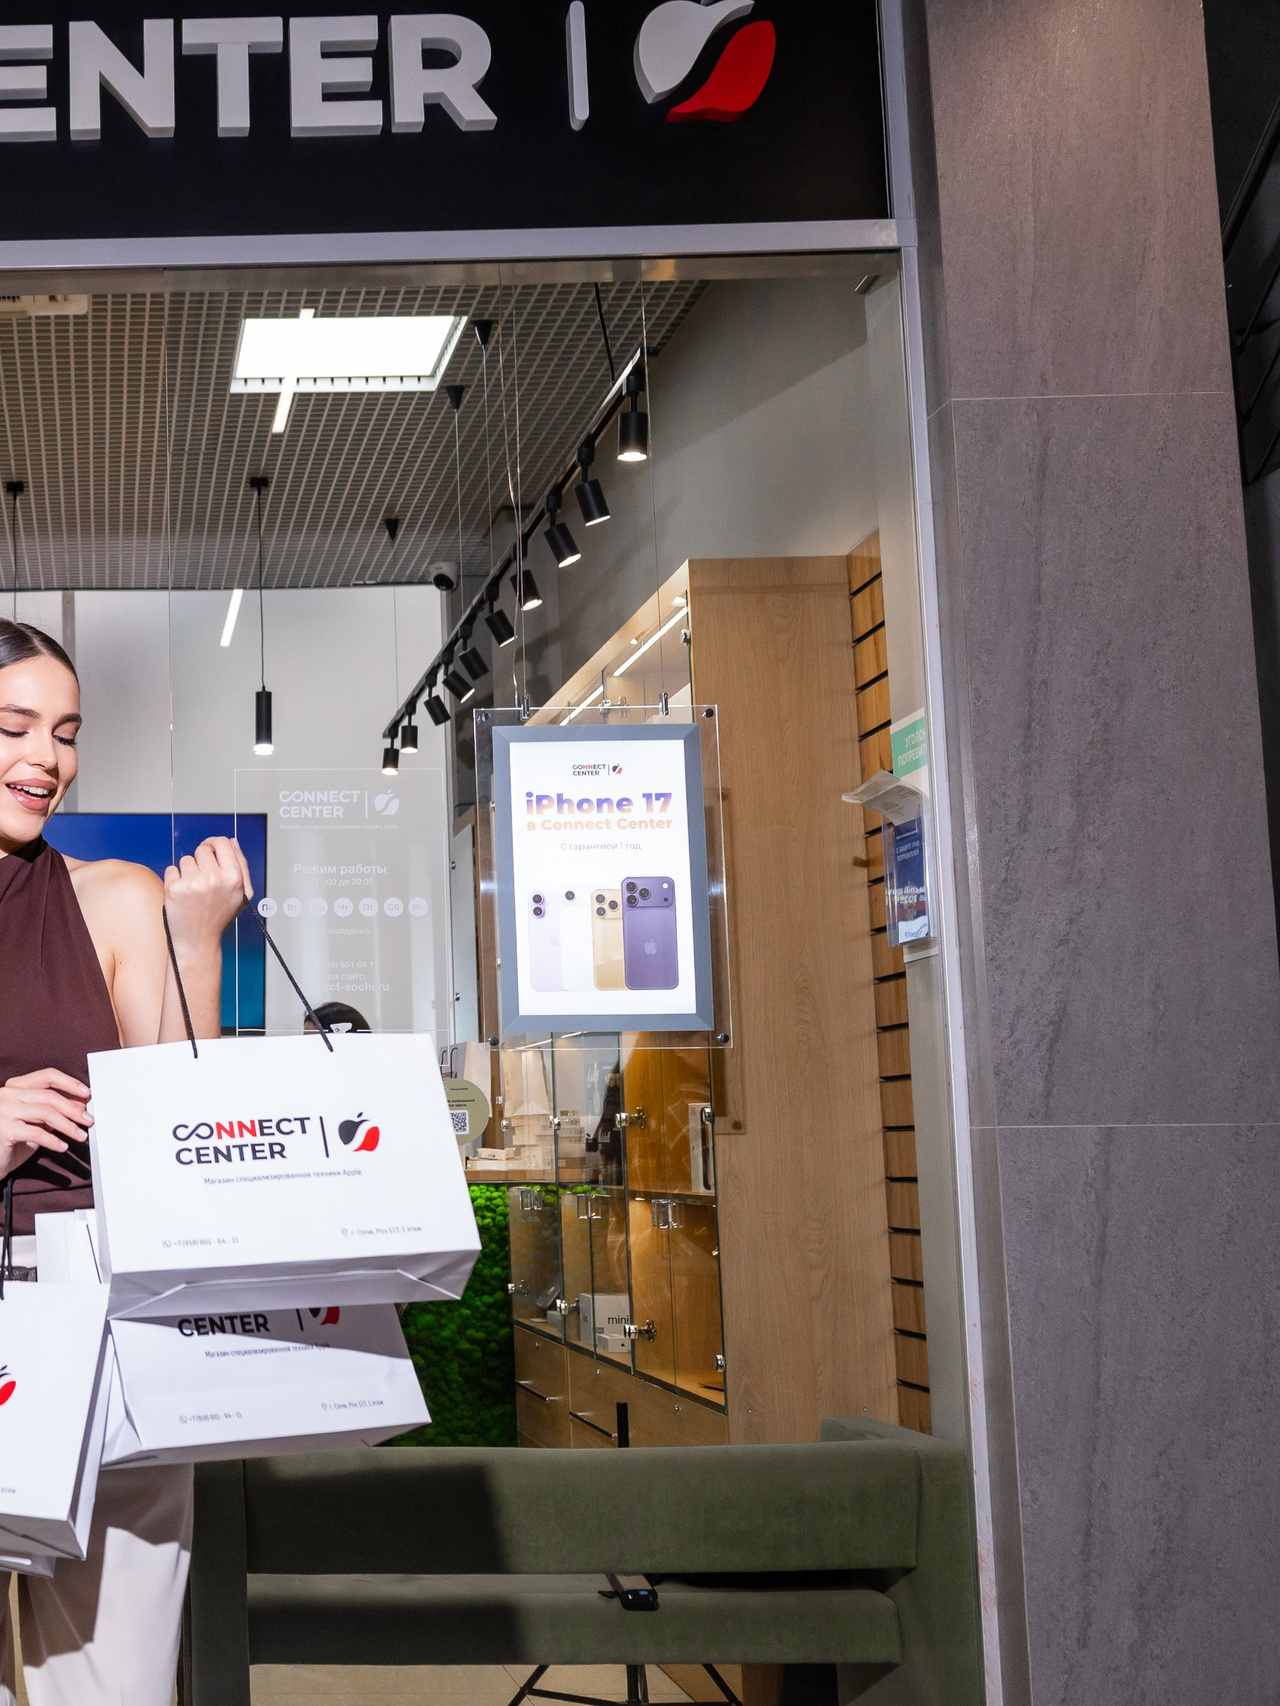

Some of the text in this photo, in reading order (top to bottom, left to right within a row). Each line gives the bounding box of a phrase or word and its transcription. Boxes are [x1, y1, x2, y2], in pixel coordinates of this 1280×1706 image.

[279, 790, 360, 803] CONNECT
[525, 791, 673, 815] iPhone 17
[279, 806, 344, 818] CENTER
[527, 818, 673, 831] в Connect Center
[570, 842, 617, 852] гарантией
[620, 842, 624, 850] 1
[625, 844, 641, 852] год
[294, 863, 387, 876] Режим работы
[339, 878, 349, 886] до
[313, 904, 324, 913] Ср
[388, 903, 400, 911] Сб
[328, 928, 371, 936] выходных
[340, 961, 354, 969] 601
[357, 961, 368, 969] 64
[172, 1117, 310, 1141] CONNECT
[175, 1142, 287, 1165] CENTER
[204, 1168, 362, 1185] Магазин специализированной техники Apple
[178, 1314, 270, 1337] CENTER
[607, 1315, 629, 1324] mini
[205, 1350, 229, 1359] Магазин
